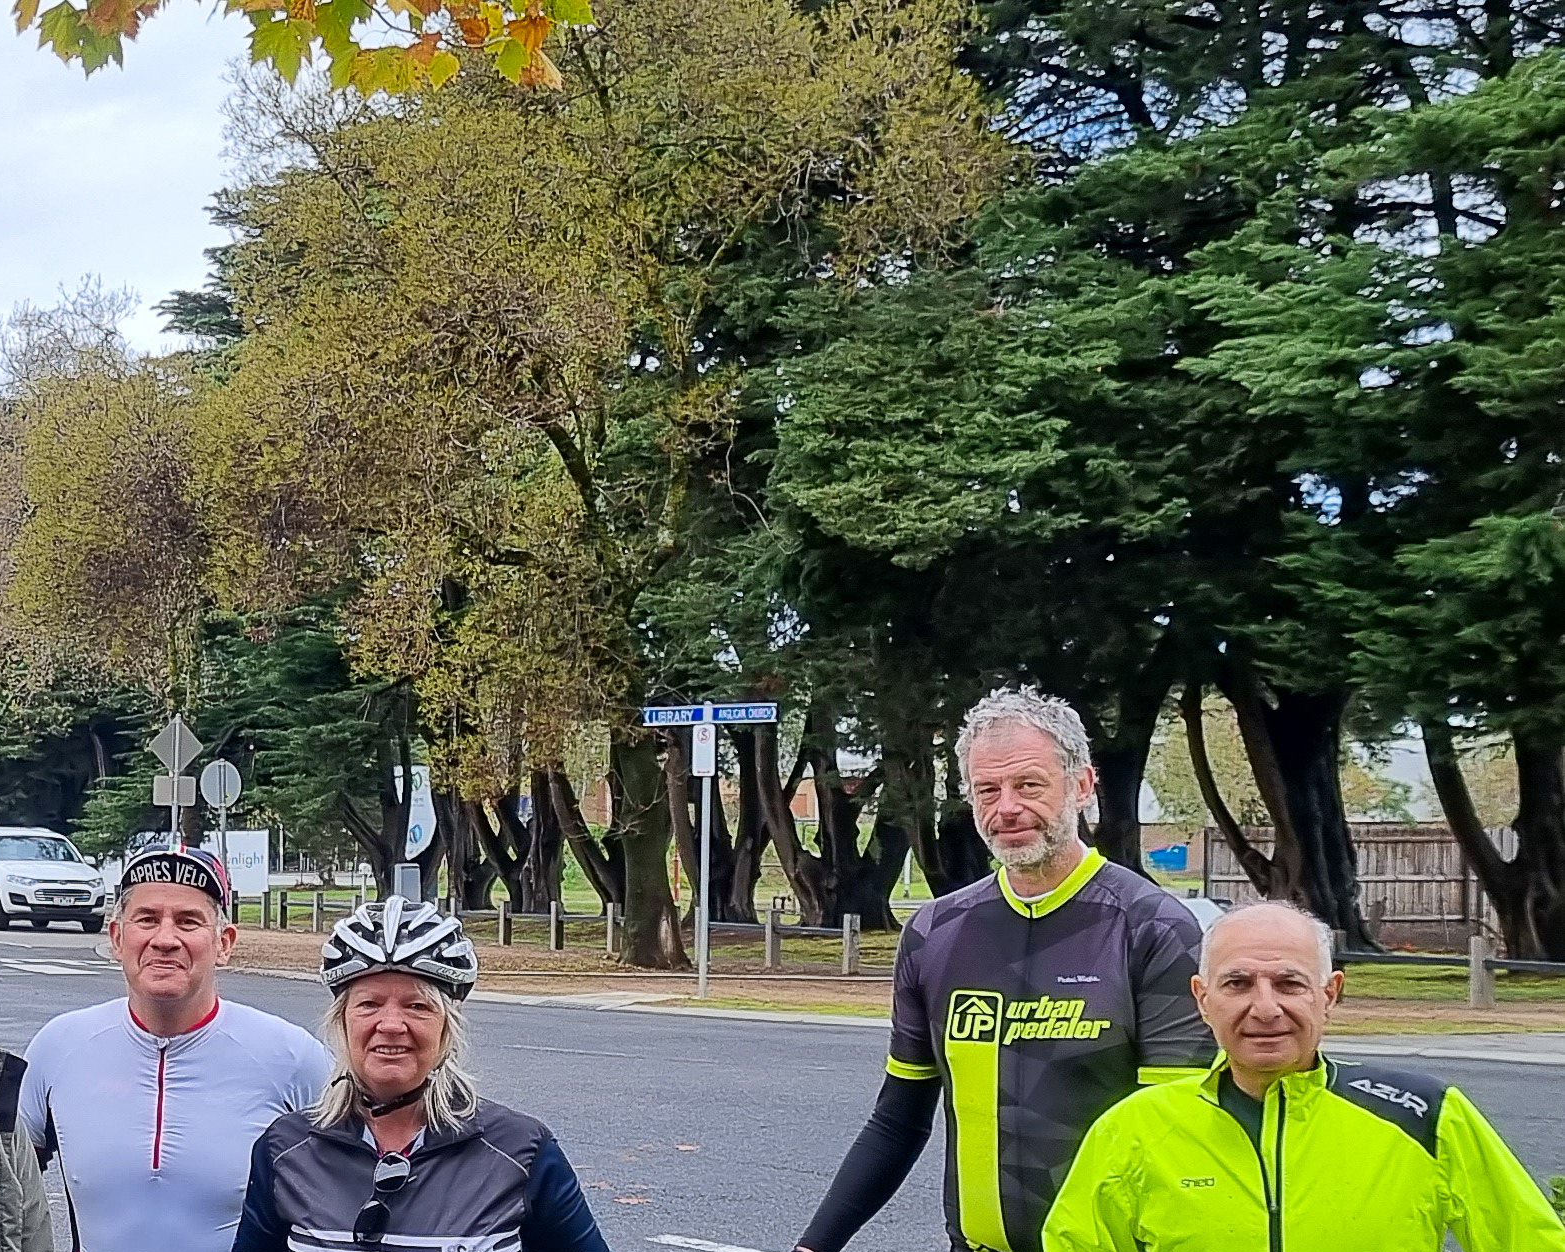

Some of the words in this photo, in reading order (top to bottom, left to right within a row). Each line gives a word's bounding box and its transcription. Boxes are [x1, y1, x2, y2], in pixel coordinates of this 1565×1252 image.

[652, 710, 694, 723] LIBRARY
[718, 708, 747, 719] ANGLICAN
[748, 707, 771, 719] CHURCH
[228, 851, 263, 869] nlight
[130, 861, 171, 884] APRÈS
[1005, 995, 1086, 1019] urban
[951, 1013, 995, 1039] UP
[1002, 1017, 1111, 1046] pedaler
[1347, 1079, 1429, 1119] AZUR
